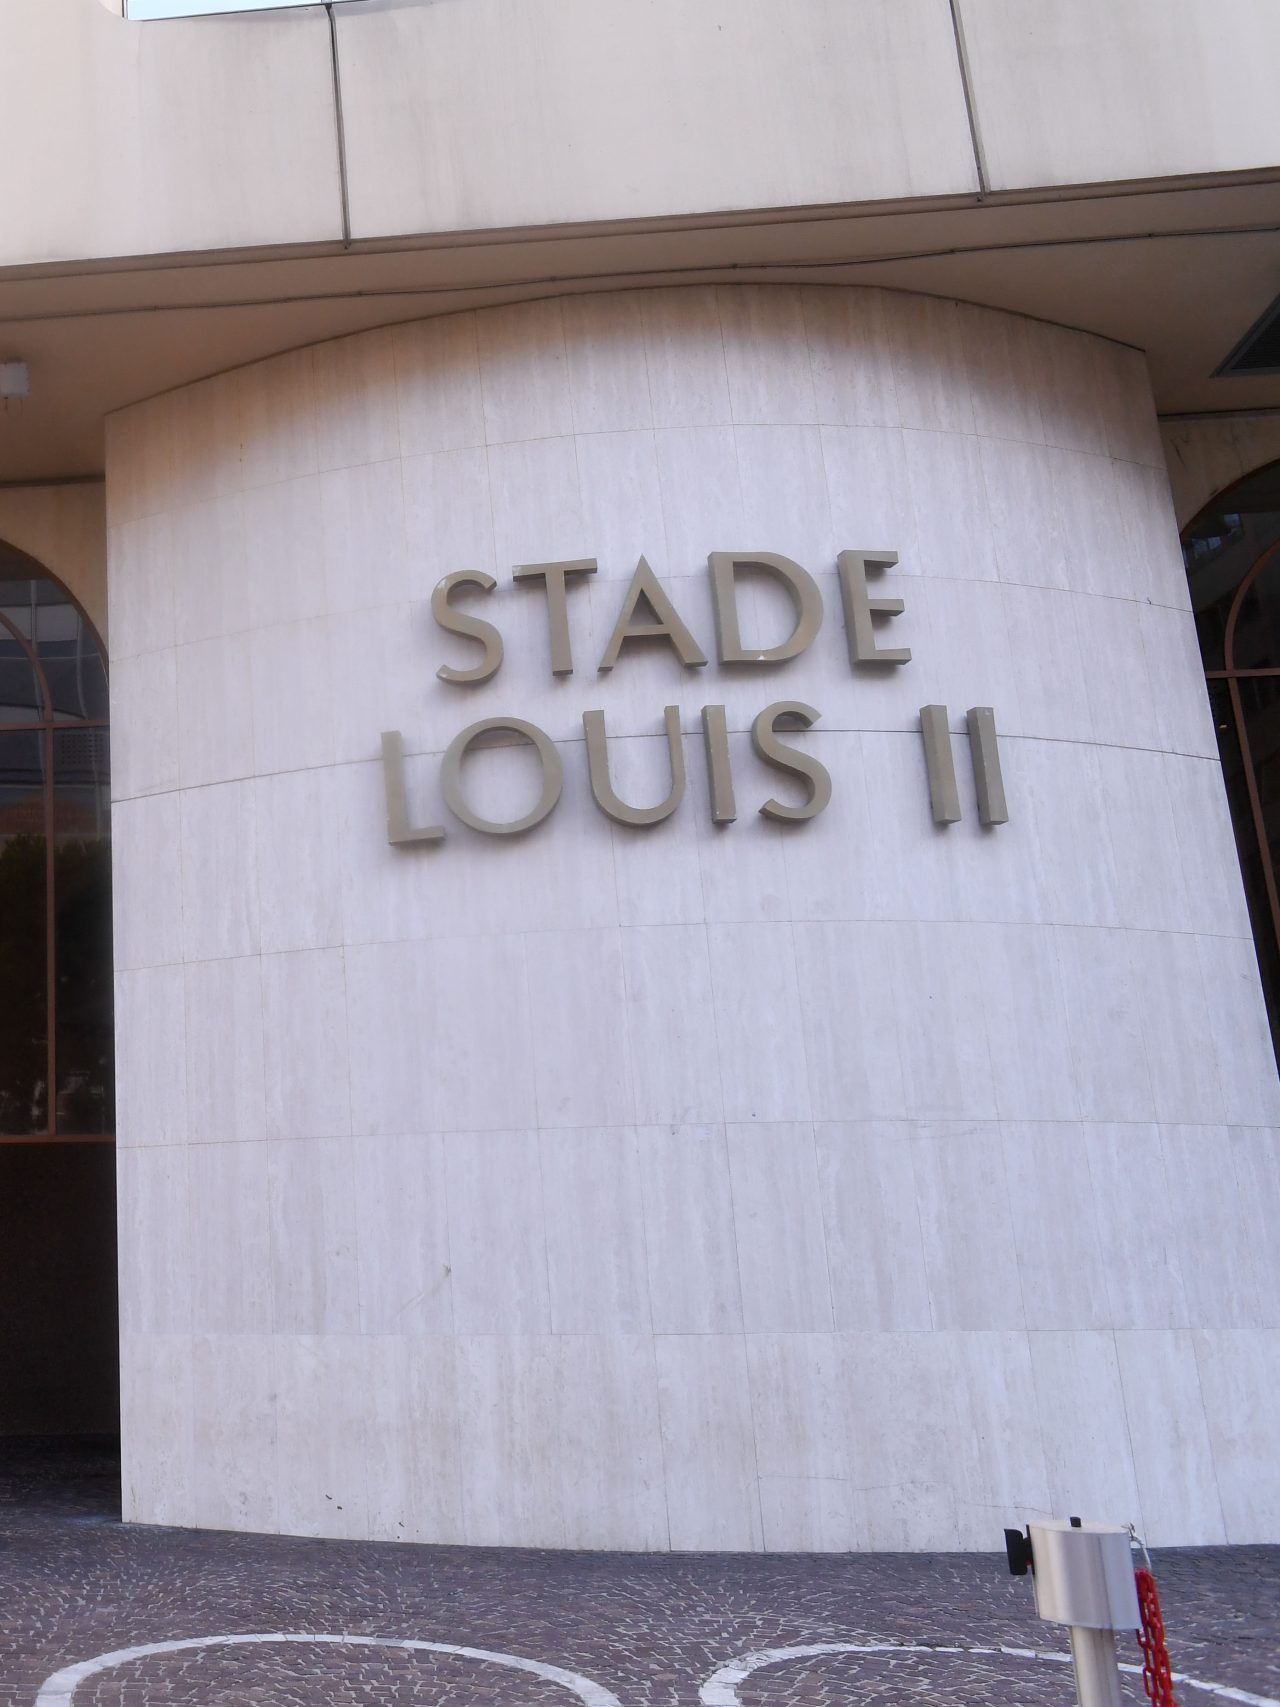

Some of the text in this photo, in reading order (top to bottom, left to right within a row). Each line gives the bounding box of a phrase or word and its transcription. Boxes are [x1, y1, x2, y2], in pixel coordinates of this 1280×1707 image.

[430, 549, 912, 685] STADE
[381, 700, 1008, 847] LOUIS II
